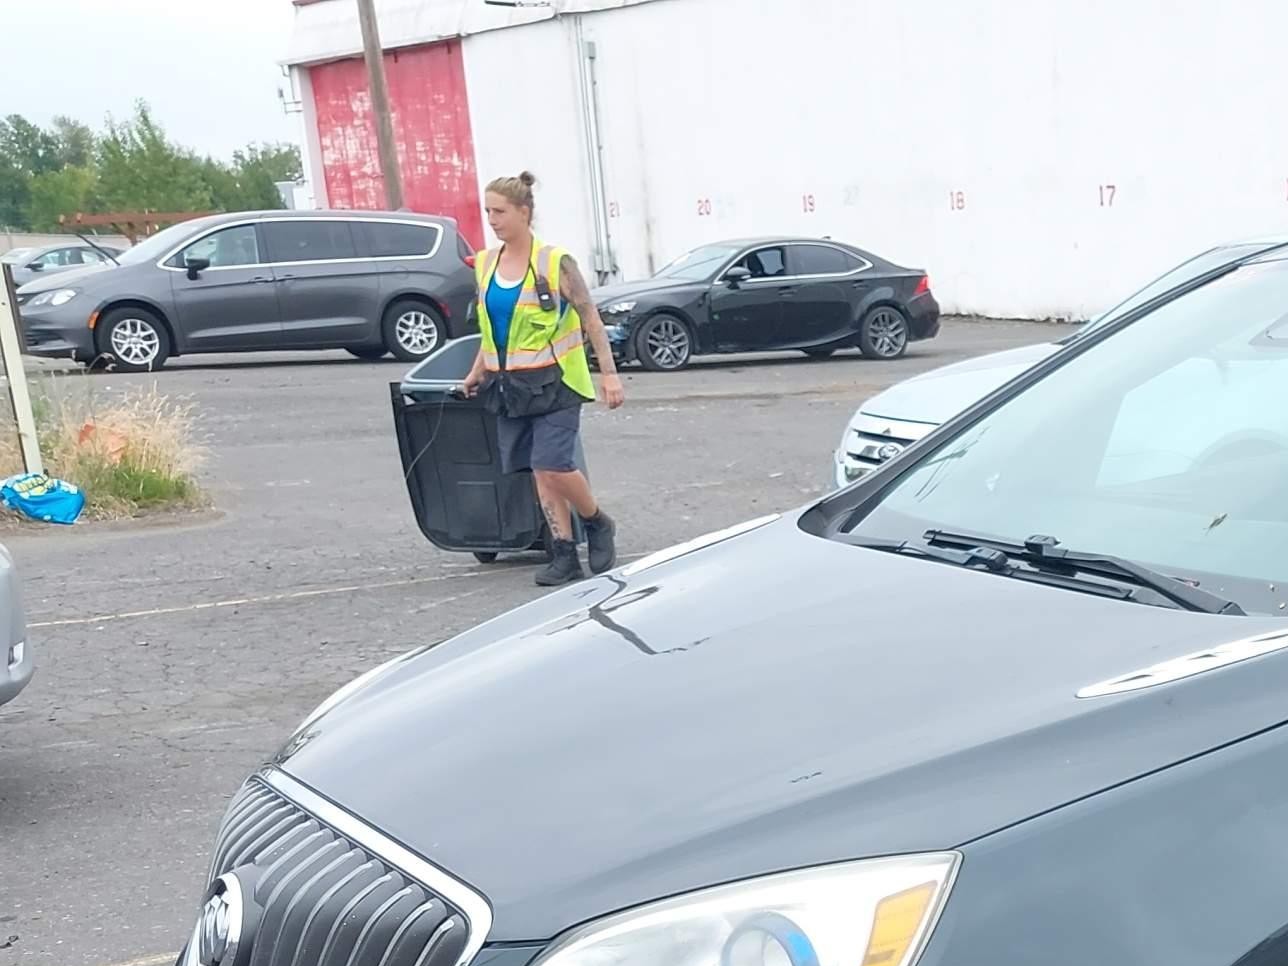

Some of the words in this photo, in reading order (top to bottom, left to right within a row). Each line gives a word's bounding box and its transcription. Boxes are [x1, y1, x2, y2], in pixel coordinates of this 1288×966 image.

[802, 194, 815, 213] 19
[949, 190, 965, 211] 18
[1098, 184, 1116, 207] 17
[697, 198, 712, 216] 20
